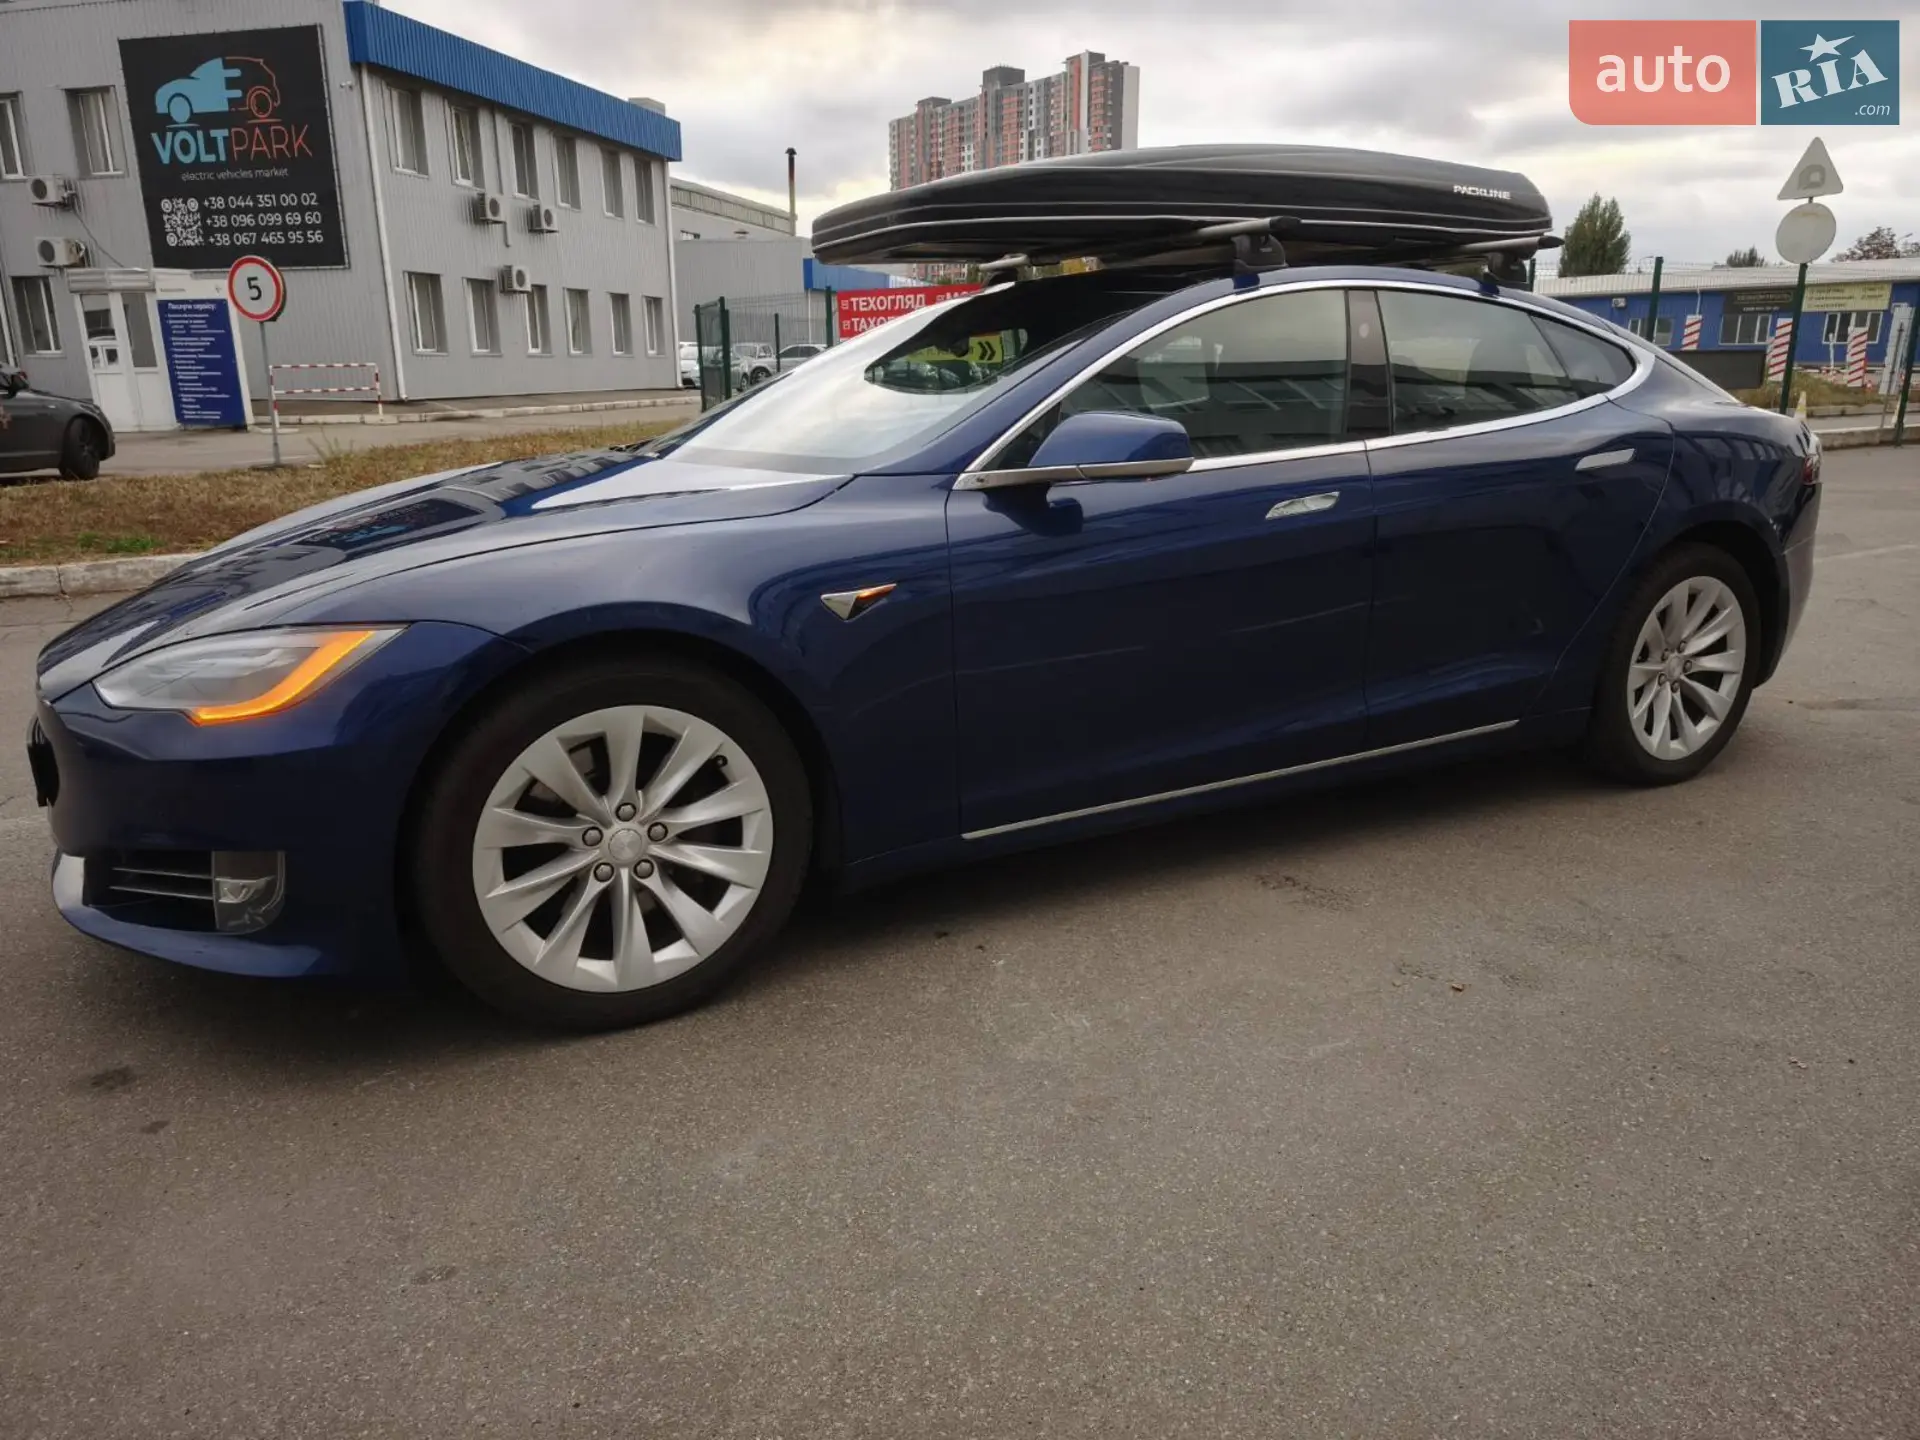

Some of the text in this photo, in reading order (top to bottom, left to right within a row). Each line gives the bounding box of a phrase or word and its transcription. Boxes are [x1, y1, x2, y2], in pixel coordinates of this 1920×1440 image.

[181, 167, 289, 181] electric vehicles market
[204, 192, 318, 209] +38 044 351 00 02
[1453, 185, 1511, 200] PACKLINE
[206, 211, 321, 227] +38 096 099 69 60
[208, 230, 323, 246] +38 067 465 95 56
[246, 276, 262, 301] 5
[850, 293, 926, 312] ТЕХОГЛЯД
